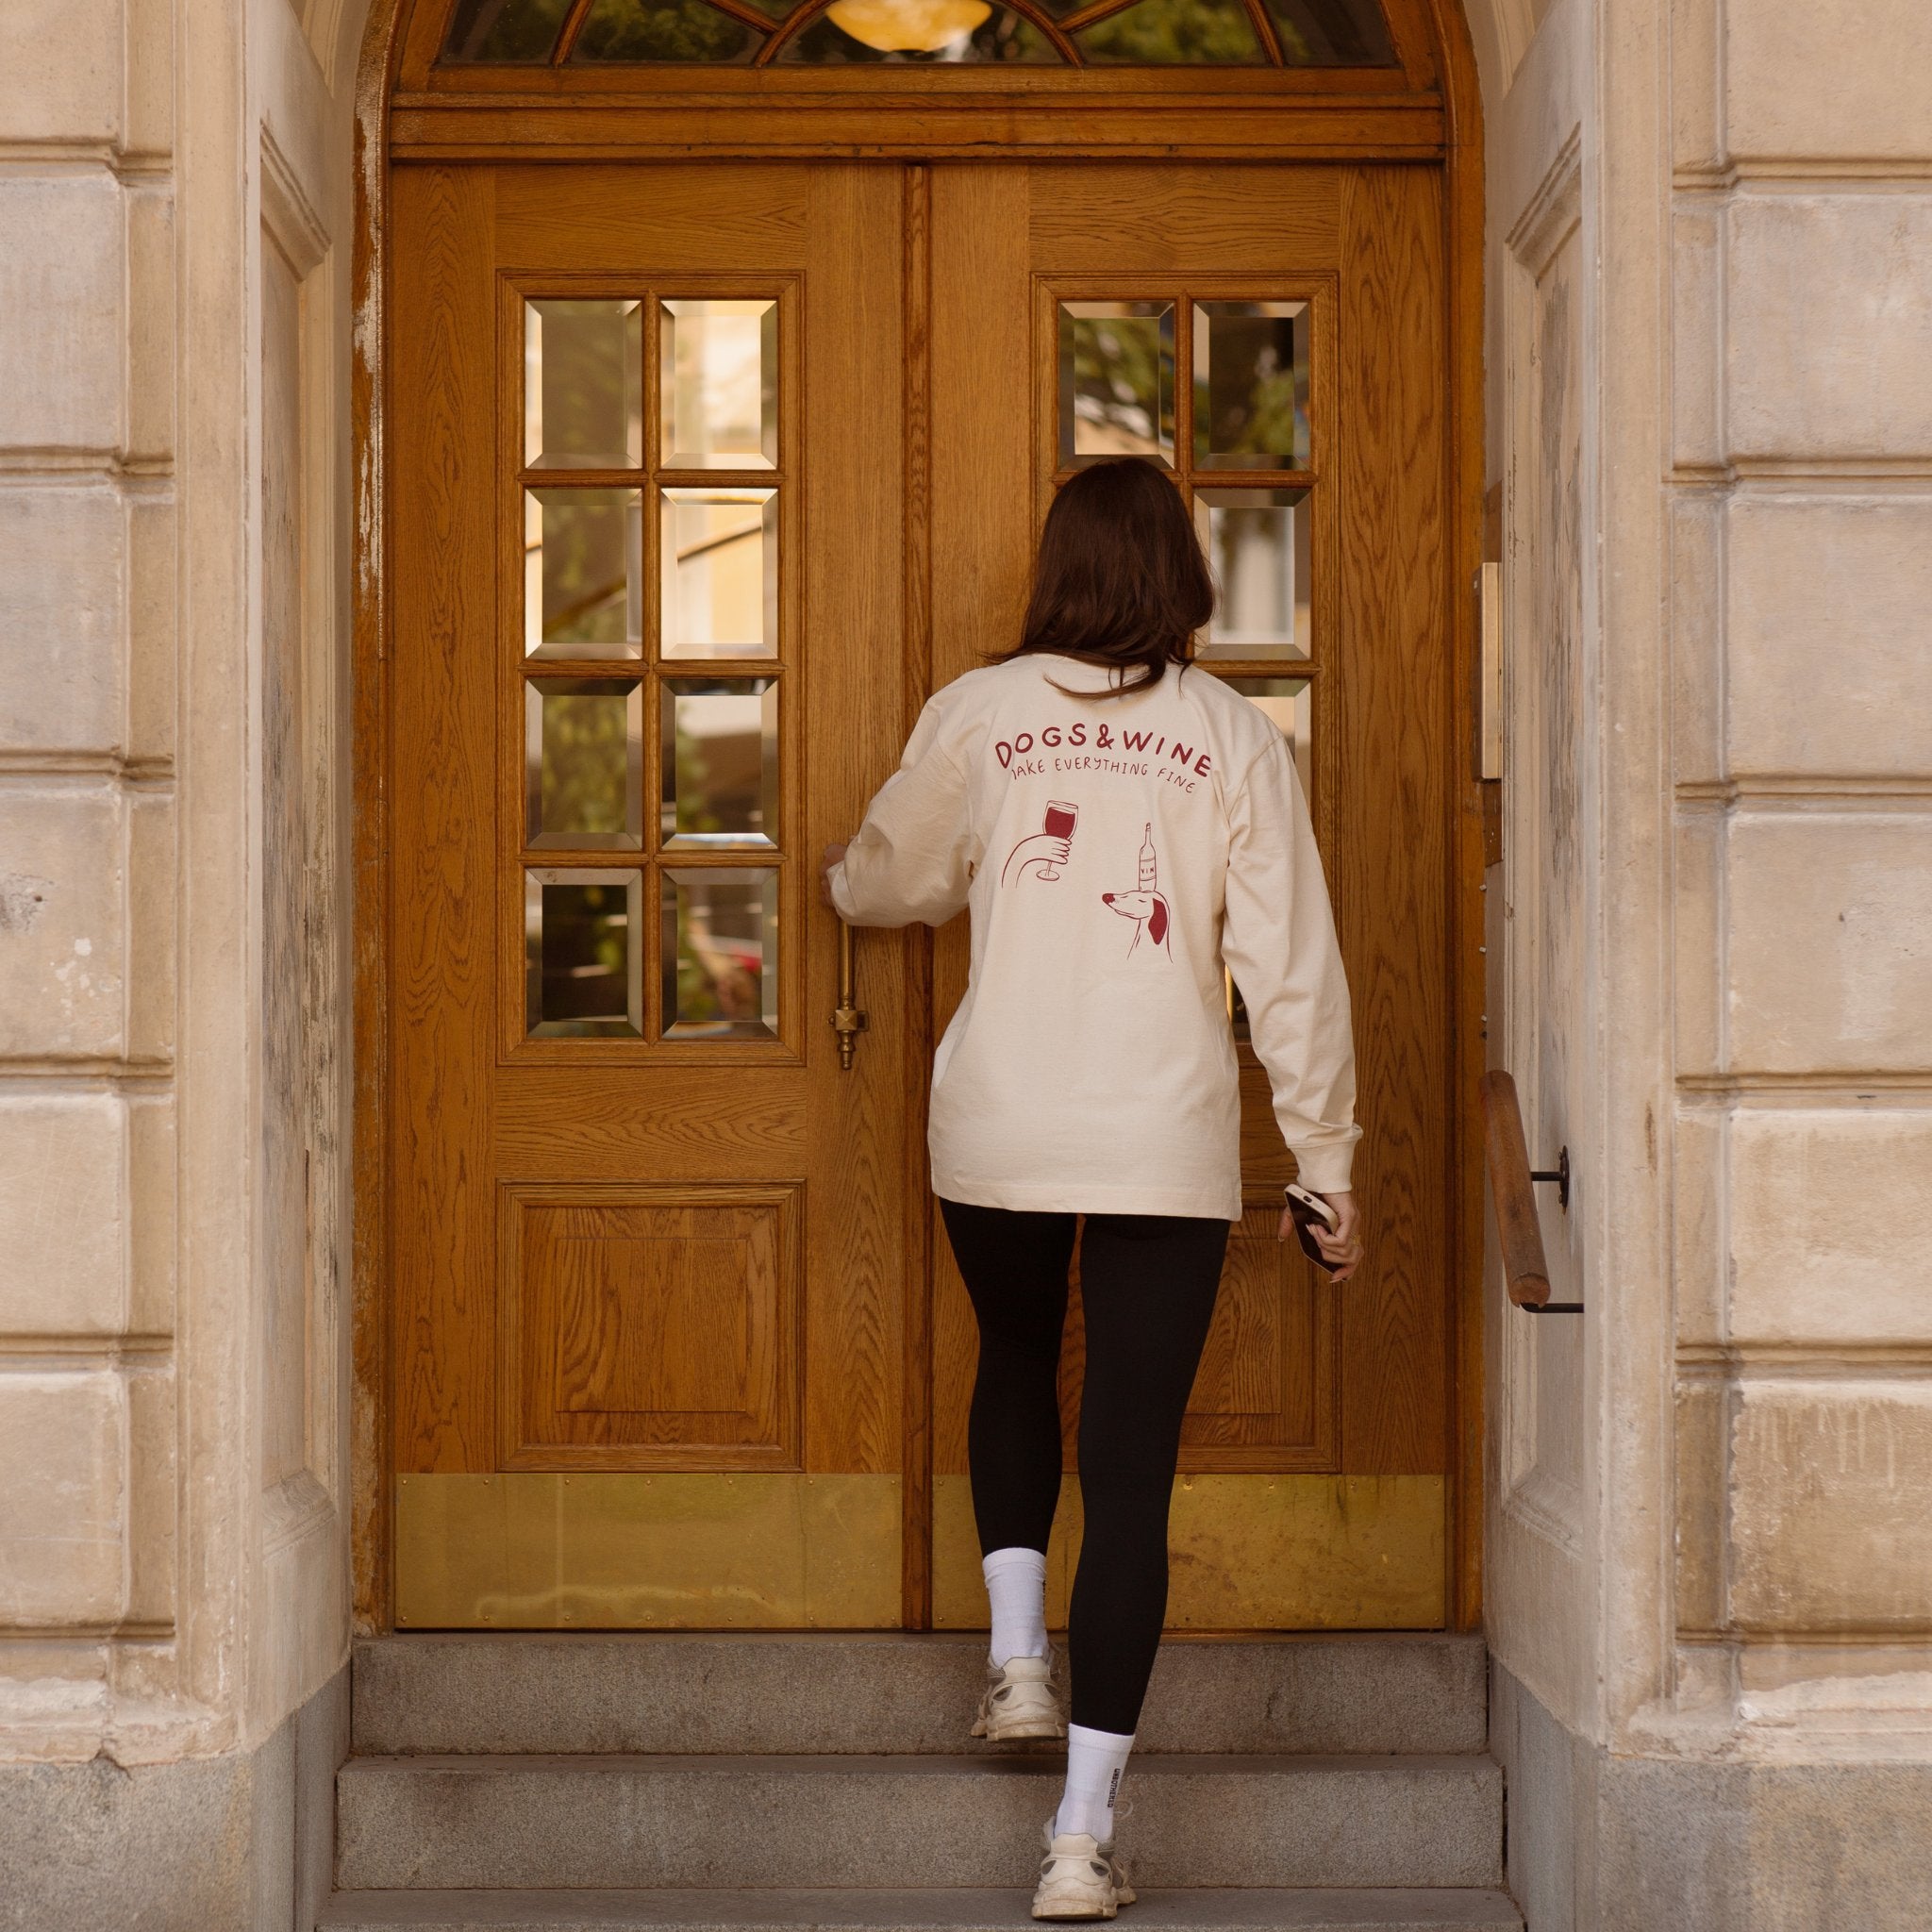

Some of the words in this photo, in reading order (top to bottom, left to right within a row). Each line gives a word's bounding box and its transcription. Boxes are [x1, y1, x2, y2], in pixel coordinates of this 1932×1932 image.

[1054, 756, 1149, 776] EVERYTHING
[1157, 767, 1197, 793] FINE
[1141, 866, 1156, 874] VIN
